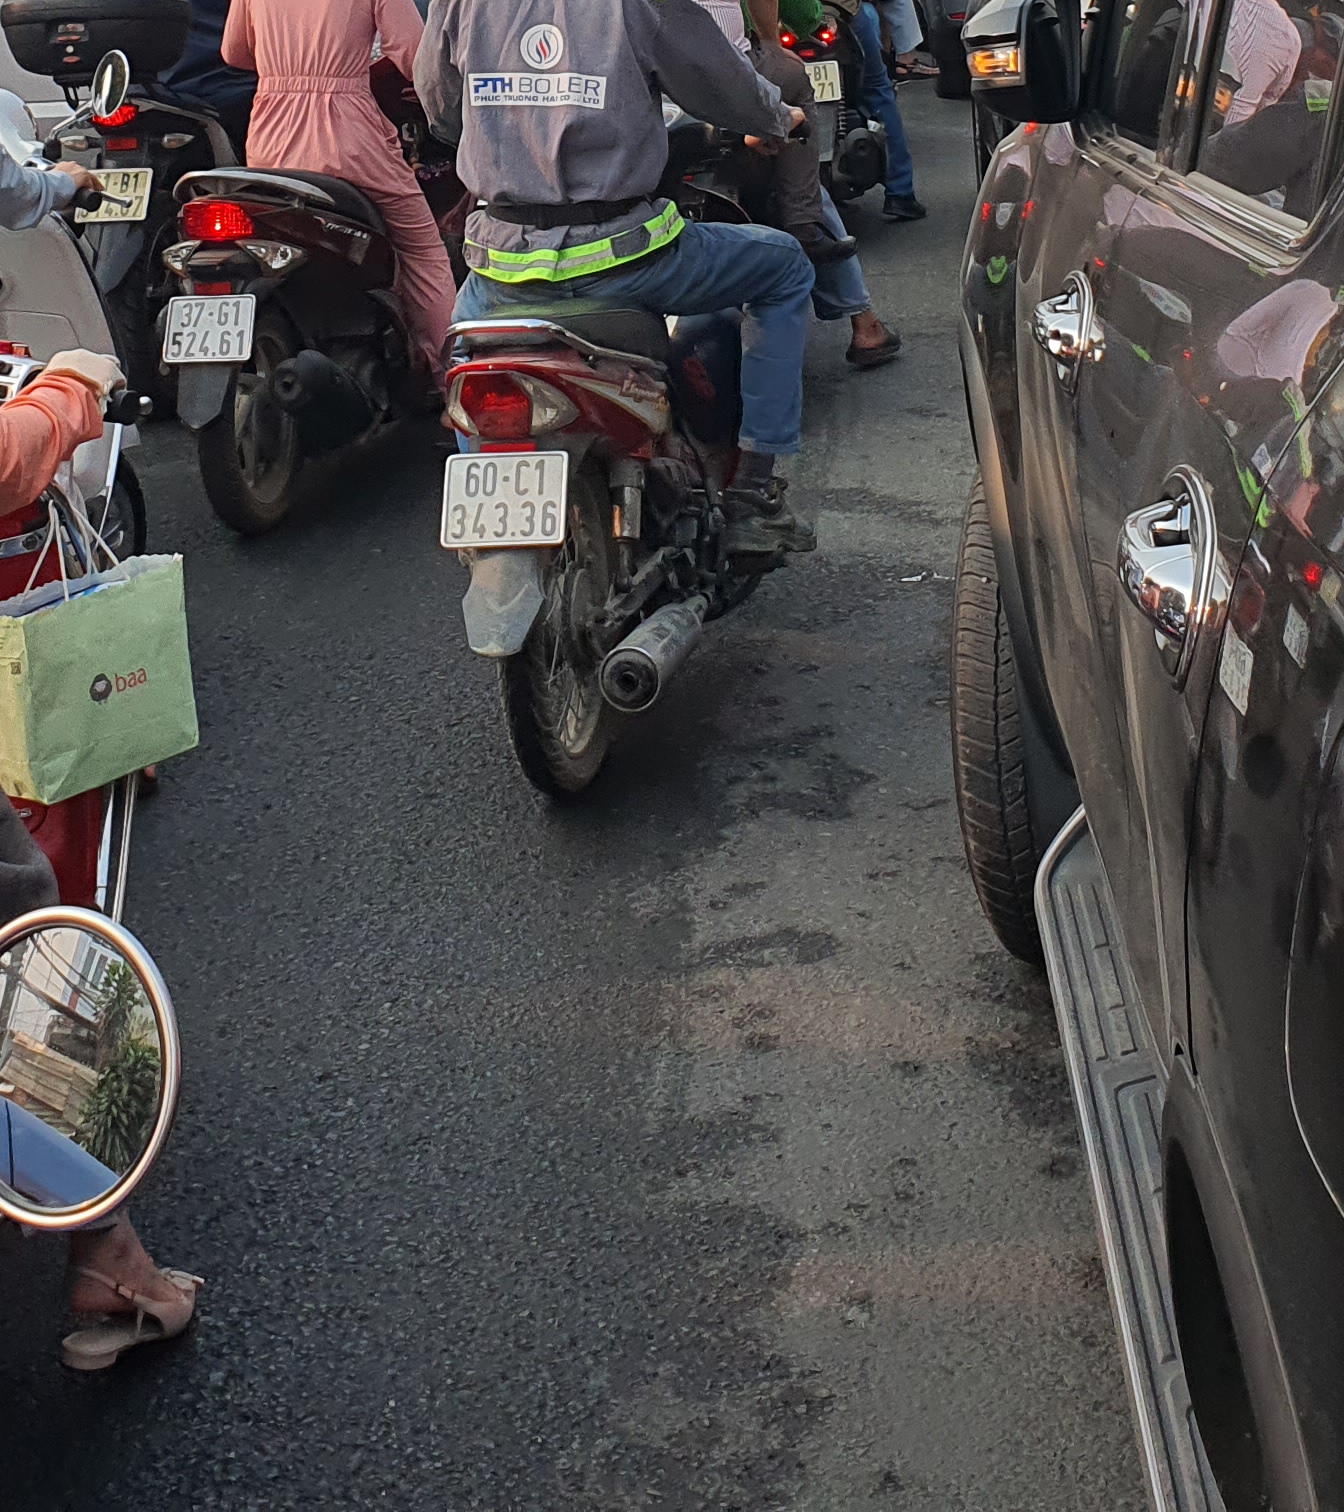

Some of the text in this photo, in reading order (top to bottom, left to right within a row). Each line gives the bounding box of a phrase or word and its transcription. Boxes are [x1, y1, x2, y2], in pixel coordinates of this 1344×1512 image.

[473, 77, 512, 94] PTH
[170, 329, 247, 360] 524.61
[450, 504, 558, 540] 343.36
[114, 667, 148, 693] baa
